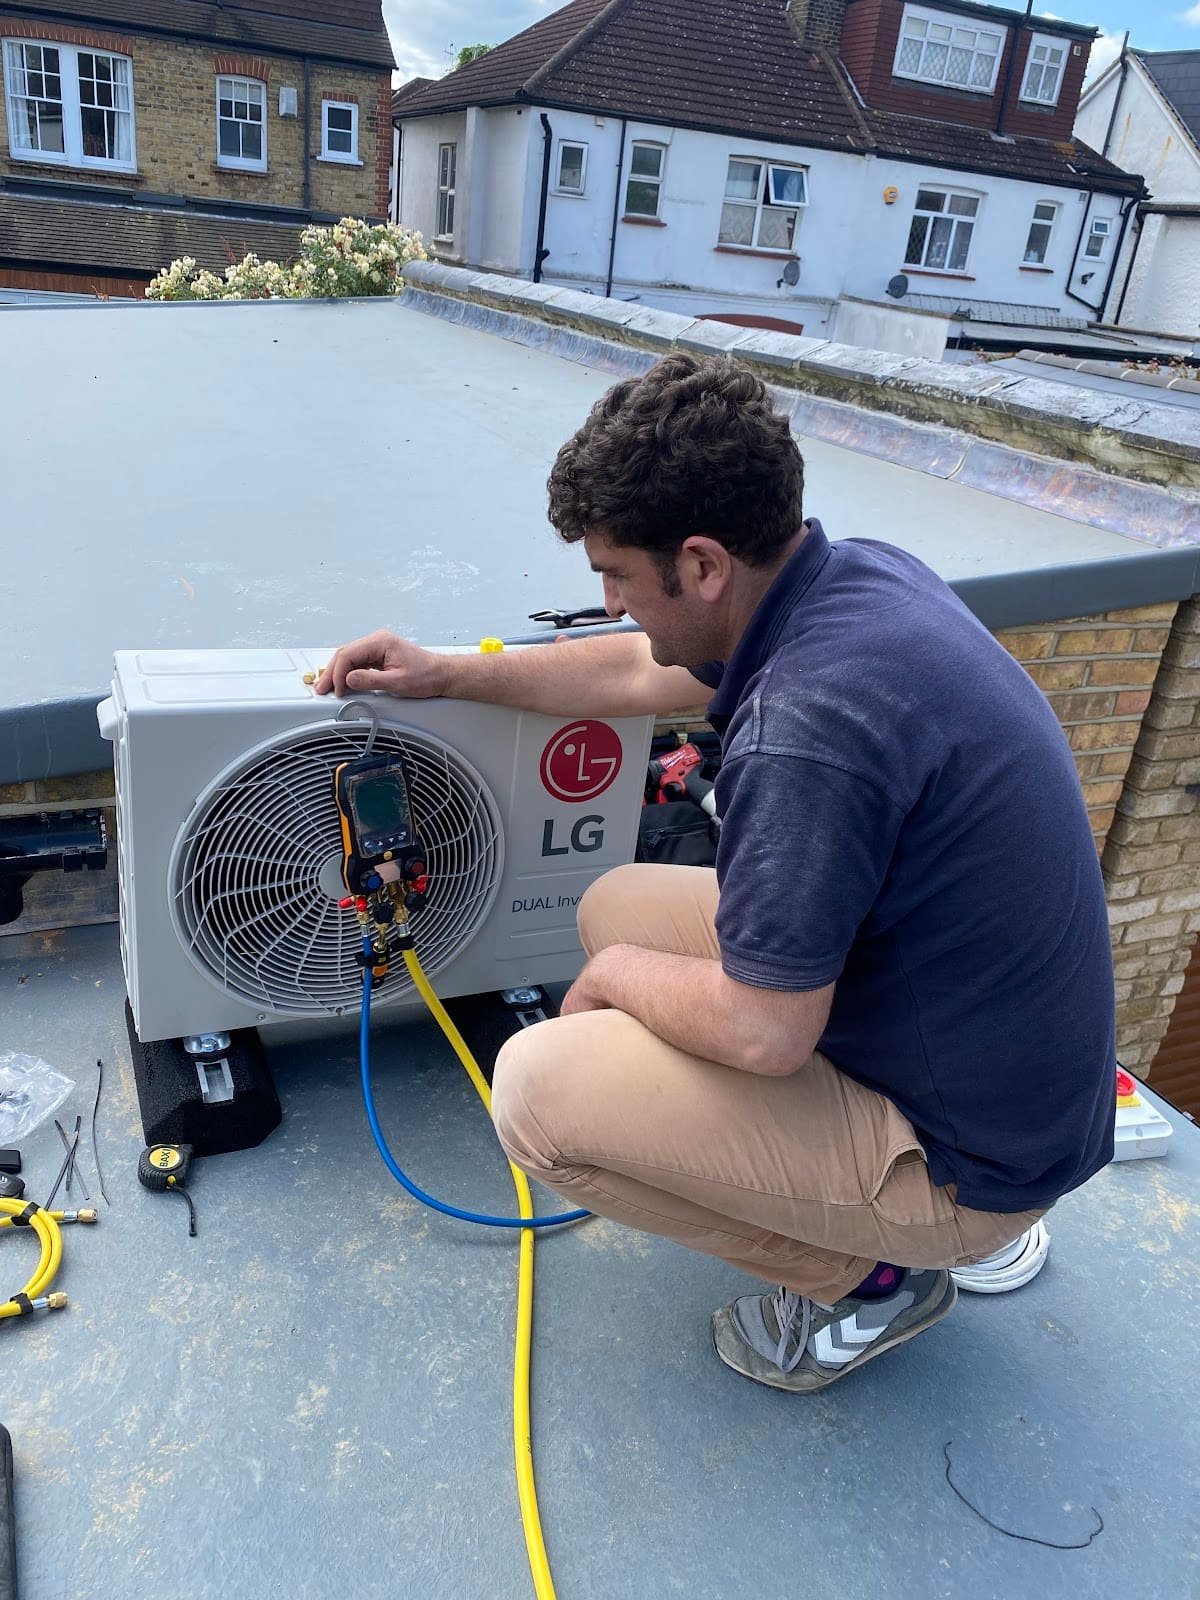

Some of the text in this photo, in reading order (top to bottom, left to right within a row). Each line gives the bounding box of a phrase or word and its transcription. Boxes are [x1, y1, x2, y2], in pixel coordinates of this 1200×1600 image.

[541, 814, 606, 857] LG
[512, 895, 583, 913] DUAL Inv
